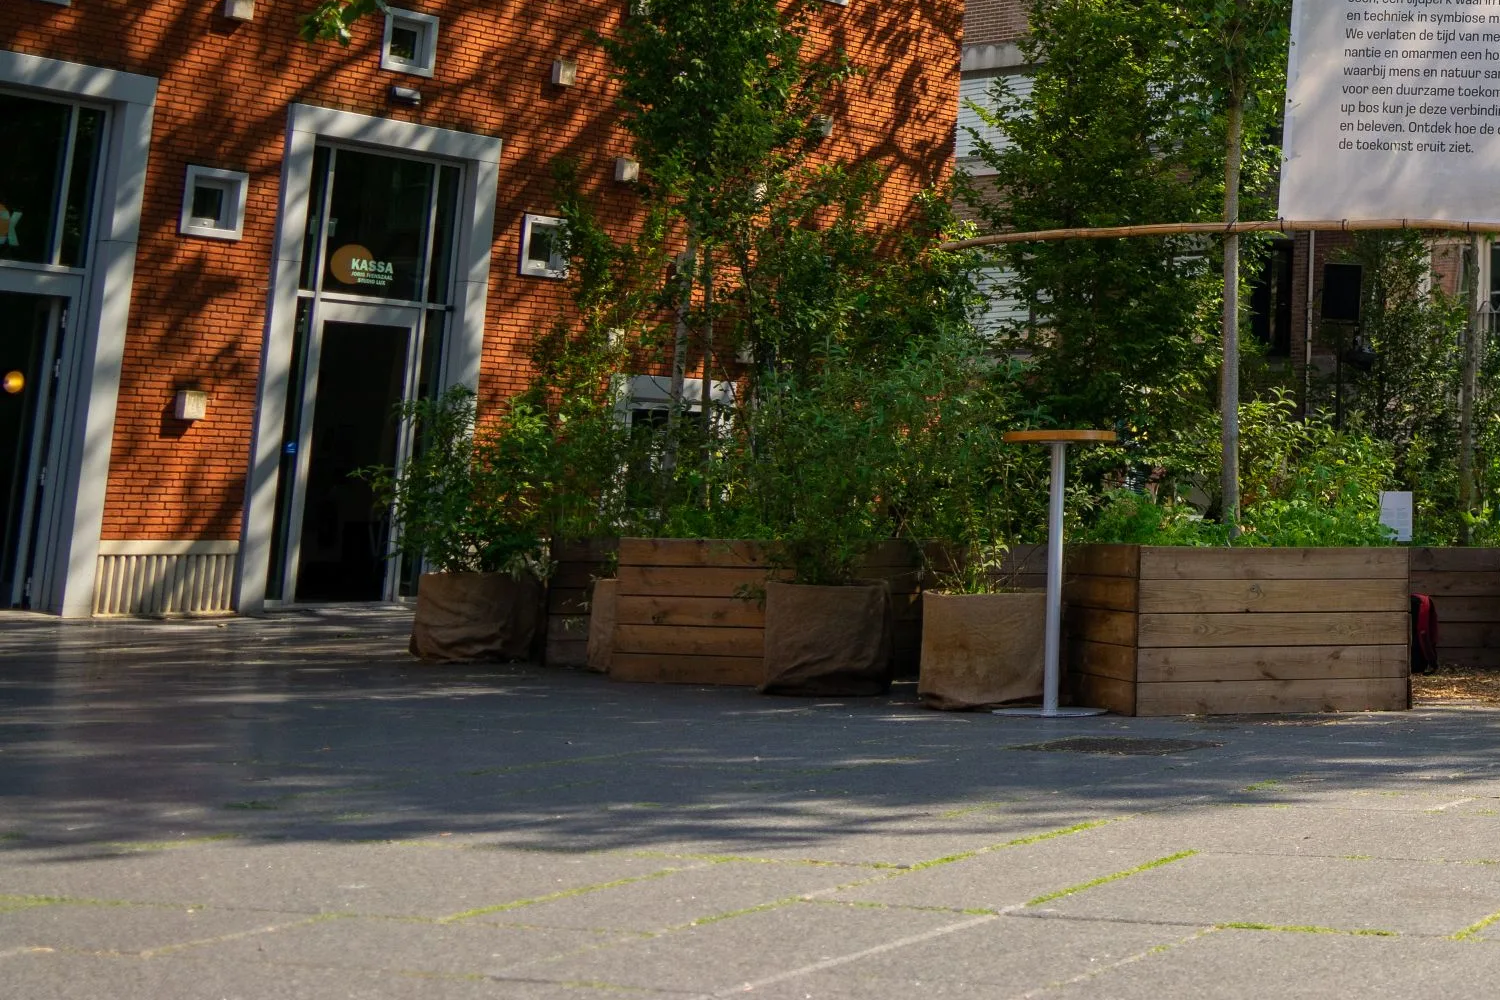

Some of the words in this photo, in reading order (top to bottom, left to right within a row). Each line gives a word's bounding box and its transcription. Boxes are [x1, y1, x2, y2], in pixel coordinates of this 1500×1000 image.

[1346, 11, 1360, 20] en
[1363, 10, 1414, 21] techniek
[1417, 12, 1427, 22] in
[1430, 12, 1485, 27] symbiose
[1345, 27, 1363, 38] We
[1366, 28, 1416, 40] verlaten
[1419, 29, 1433, 40] de
[1436, 29, 1455, 43] tijd
[1458, 33, 1479, 42] van
[1344, 46, 1381, 57] nantie
[1384, 50, 1398, 59] en
[1401, 50, 1457, 60] omarmen
[1460, 51, 1482, 61] een
[1343, 65, 1385, 79] waarbij
[1388, 68, 1420, 77] mens
[1423, 69, 1437, 78] en
[1440, 66, 1481, 78] natuur
[1342, 85, 1368, 95] voor
[1371, 85, 1392, 94] een
[1395, 84, 1454, 96] duurzame
[1339, 122, 1353, 131] en
[1357, 120, 1404, 132] beleven.
[1408, 121, 1451, 133] Ontdek
[1454, 123, 1476, 134] hoe
[1479, 123, 1494, 134] de
[1338, 138, 1353, 149] de
[1355, 139, 1413, 151] toekomst
[1416, 140, 1445, 152] eruit
[1448, 141, 1473, 152] ziet.
[351, 258, 394, 274] KASSA
